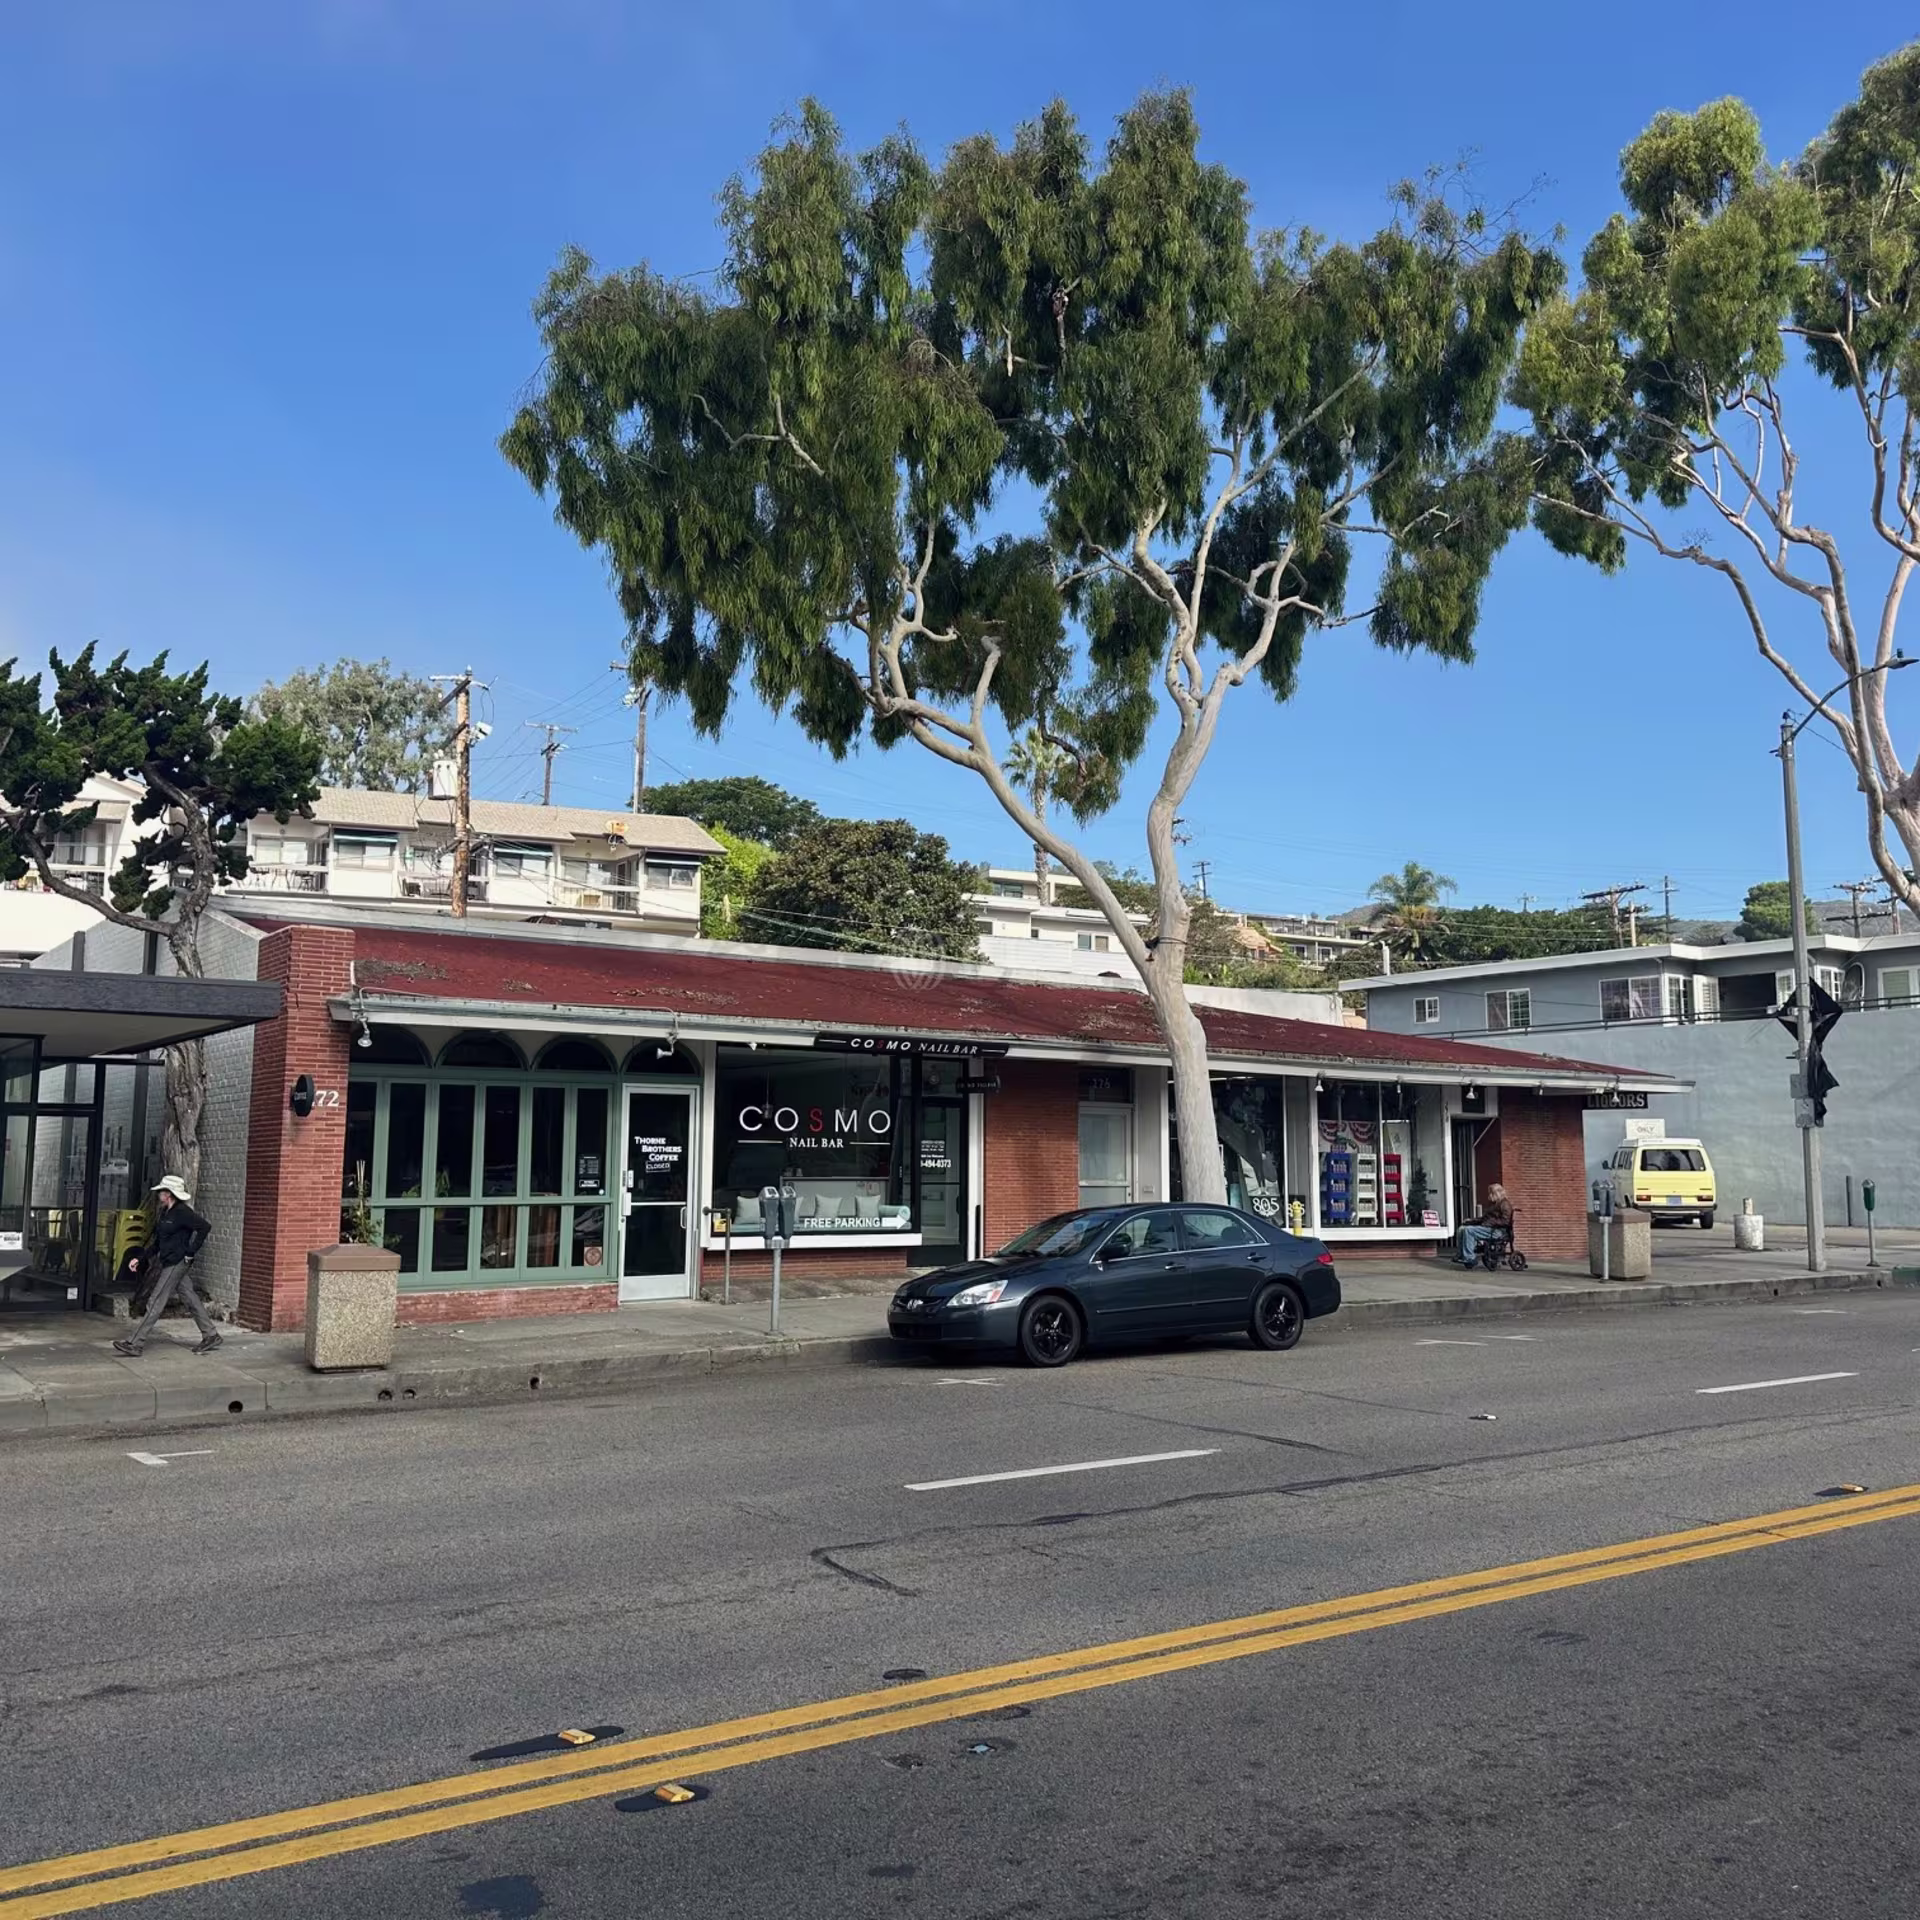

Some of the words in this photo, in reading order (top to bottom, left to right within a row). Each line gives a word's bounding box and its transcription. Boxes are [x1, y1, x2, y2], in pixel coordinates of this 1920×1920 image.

[850, 1037, 911, 1051] COSMO
[918, 1042, 950, 1053] NAIL
[952, 1044, 979, 1055] BAR
[311, 1090, 340, 1107] 72
[1587, 1093, 1645, 1108] LIQUORS
[739, 1105, 892, 1135] COSMO
[789, 1137, 818, 1149] NAIL
[821, 1138, 845, 1149] BAR
[1252, 1197, 1280, 1213] 805
[804, 1218, 833, 1229] FREE
[834, 1216, 881, 1229] PARKING
